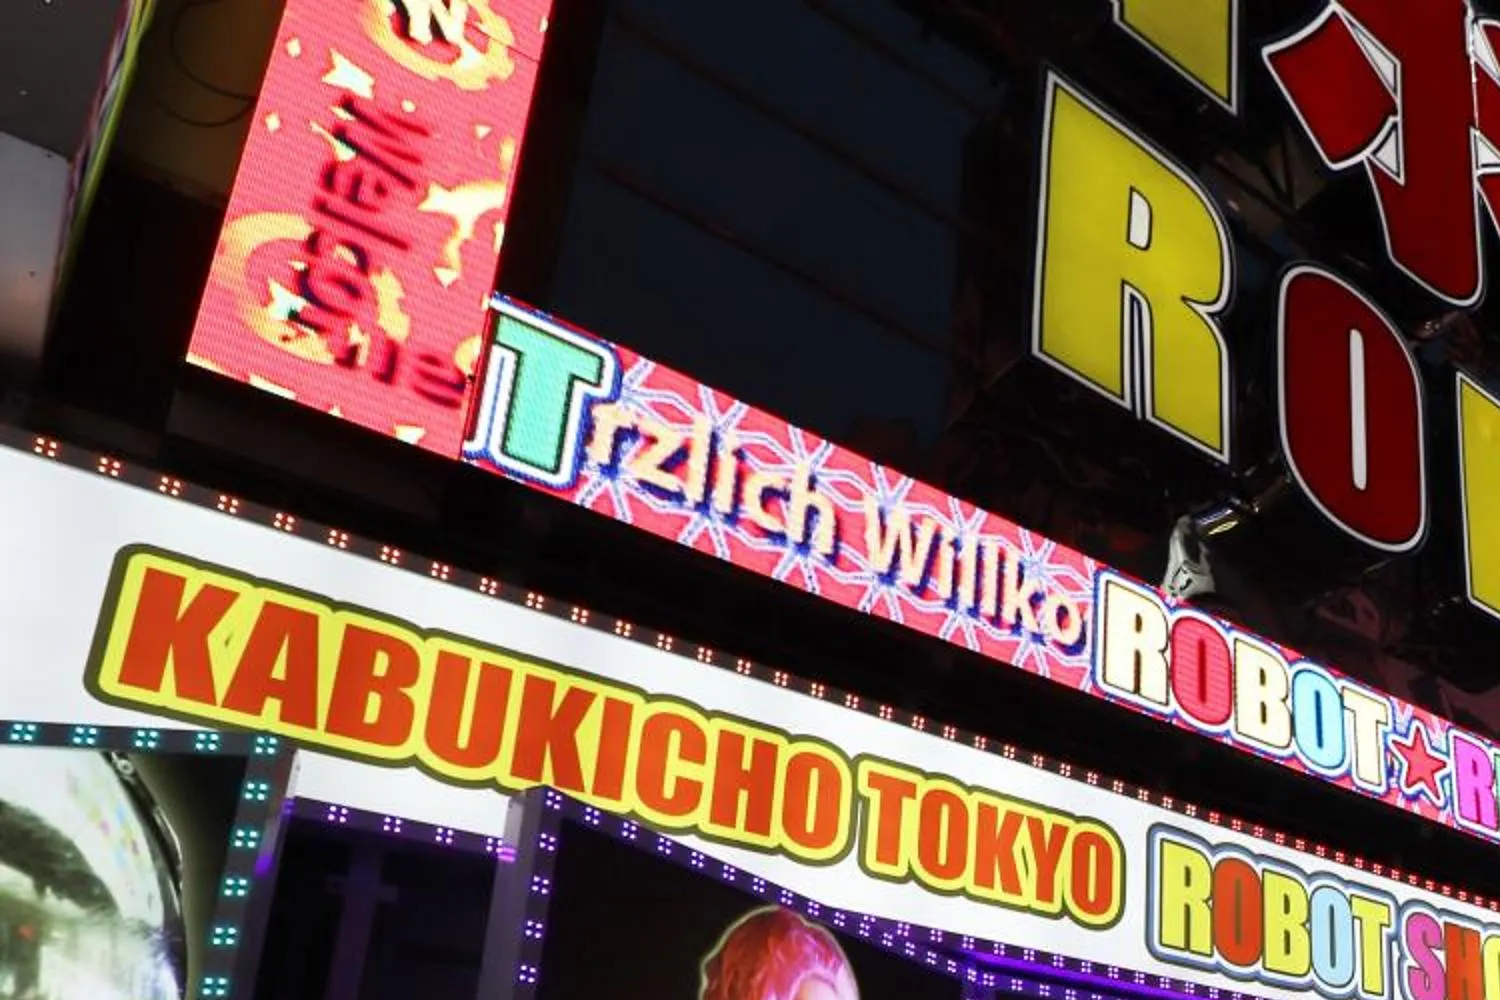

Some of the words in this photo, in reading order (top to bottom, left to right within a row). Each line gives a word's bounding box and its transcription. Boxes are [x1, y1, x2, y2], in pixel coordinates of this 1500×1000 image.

[116, 564, 842, 853] KABUKICHO
[866, 769, 1116, 917] TOKYO
[1101, 576, 1390, 788] ROBOT
[1159, 837, 1391, 998] ROBOT
